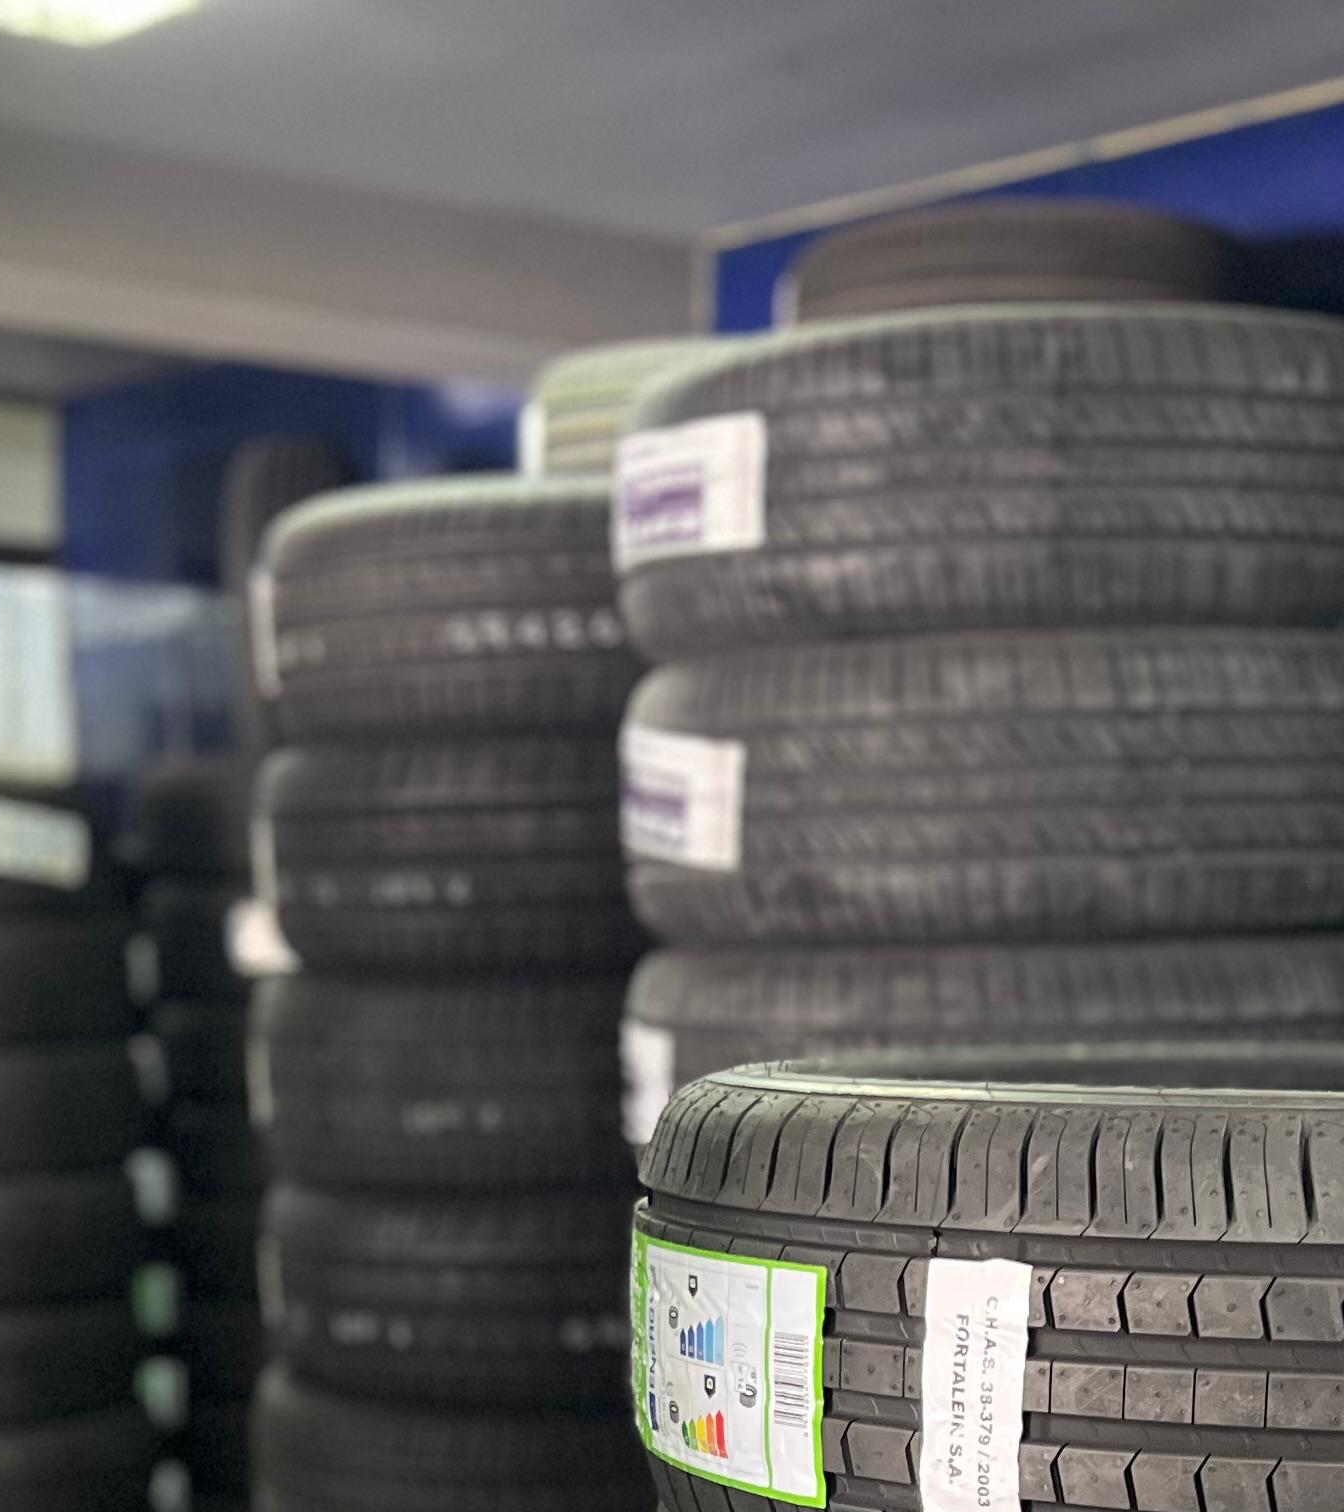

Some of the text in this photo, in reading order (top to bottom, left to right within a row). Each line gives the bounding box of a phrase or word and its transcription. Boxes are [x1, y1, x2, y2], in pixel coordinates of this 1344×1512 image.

[981, 1296, 999, 1375] C.H.A.S.
[979, 1383, 993, 1446] 38-379
[947, 1445, 963, 1484] S.A.
[977, 1464, 990, 1507] 2003
